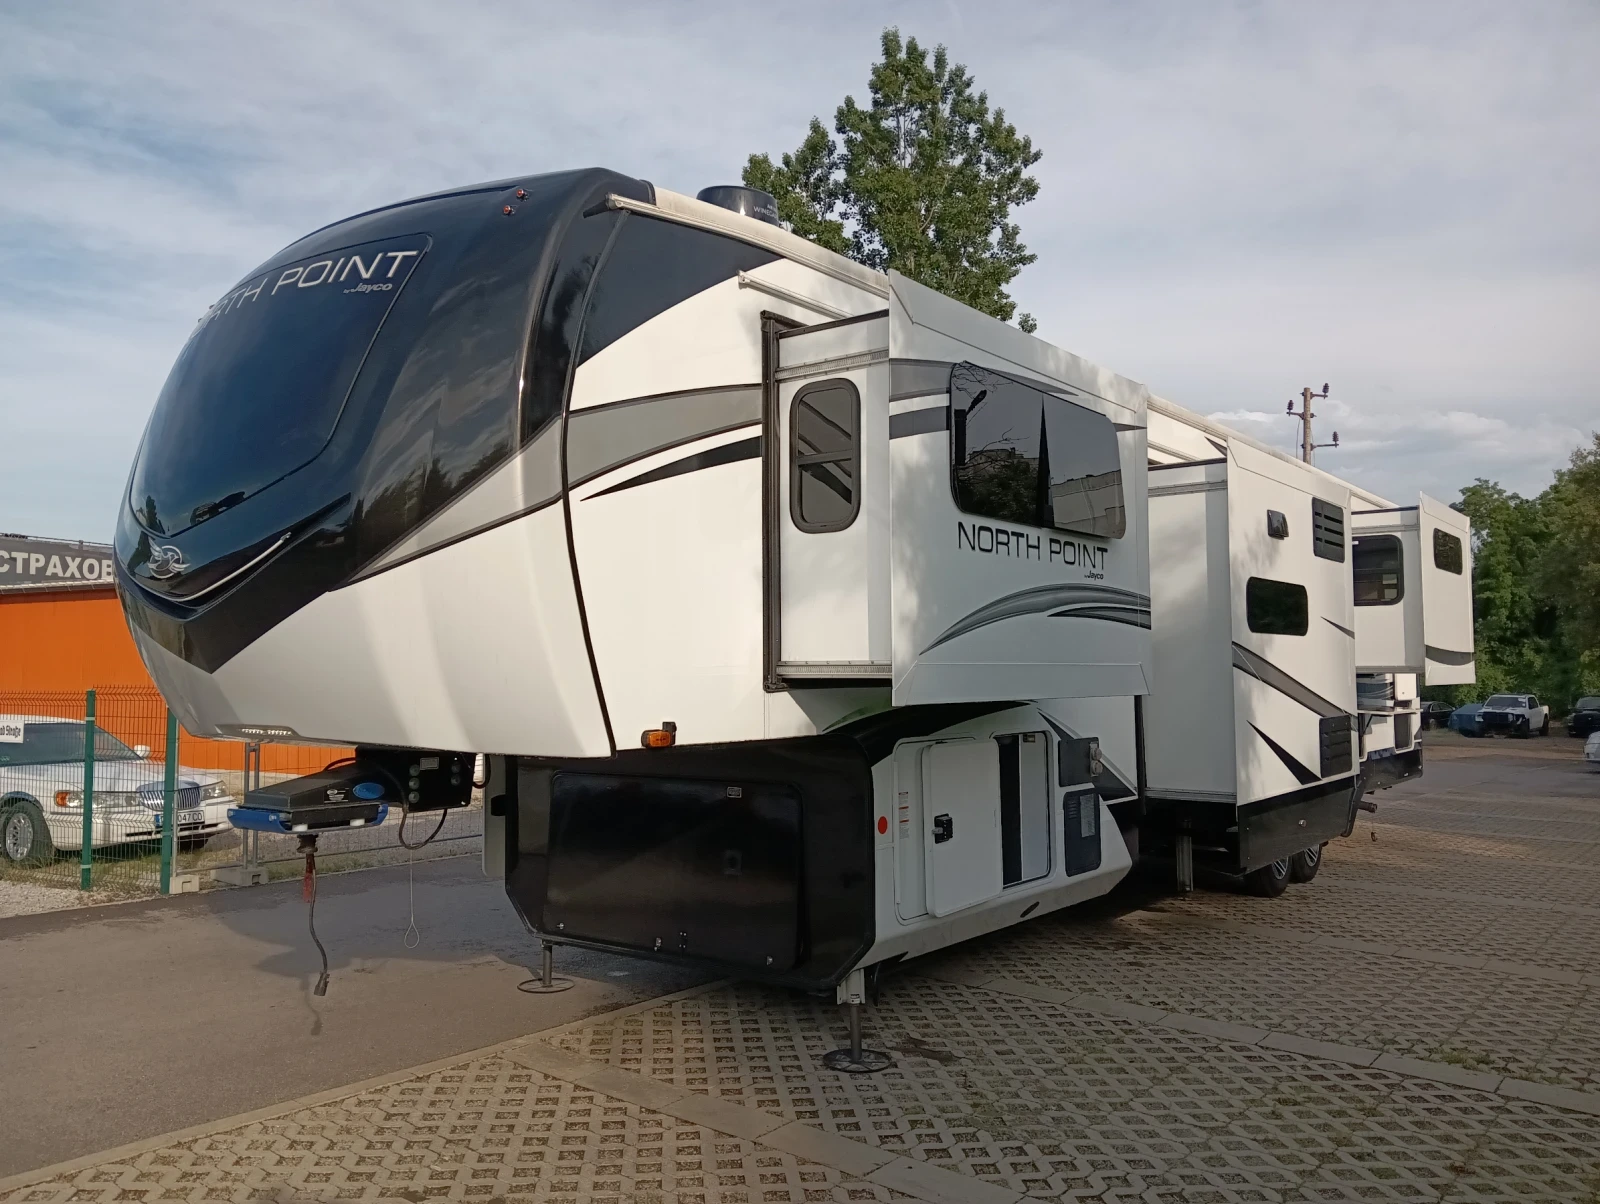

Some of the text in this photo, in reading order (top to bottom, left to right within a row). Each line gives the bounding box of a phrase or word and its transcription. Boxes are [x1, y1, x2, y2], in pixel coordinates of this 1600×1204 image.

[271, 250, 419, 296] POINT
[350, 282, 393, 294] Jayco
[957, 521, 1109, 570] NORTH POINT
[1087, 570, 1104, 581] Jayco
